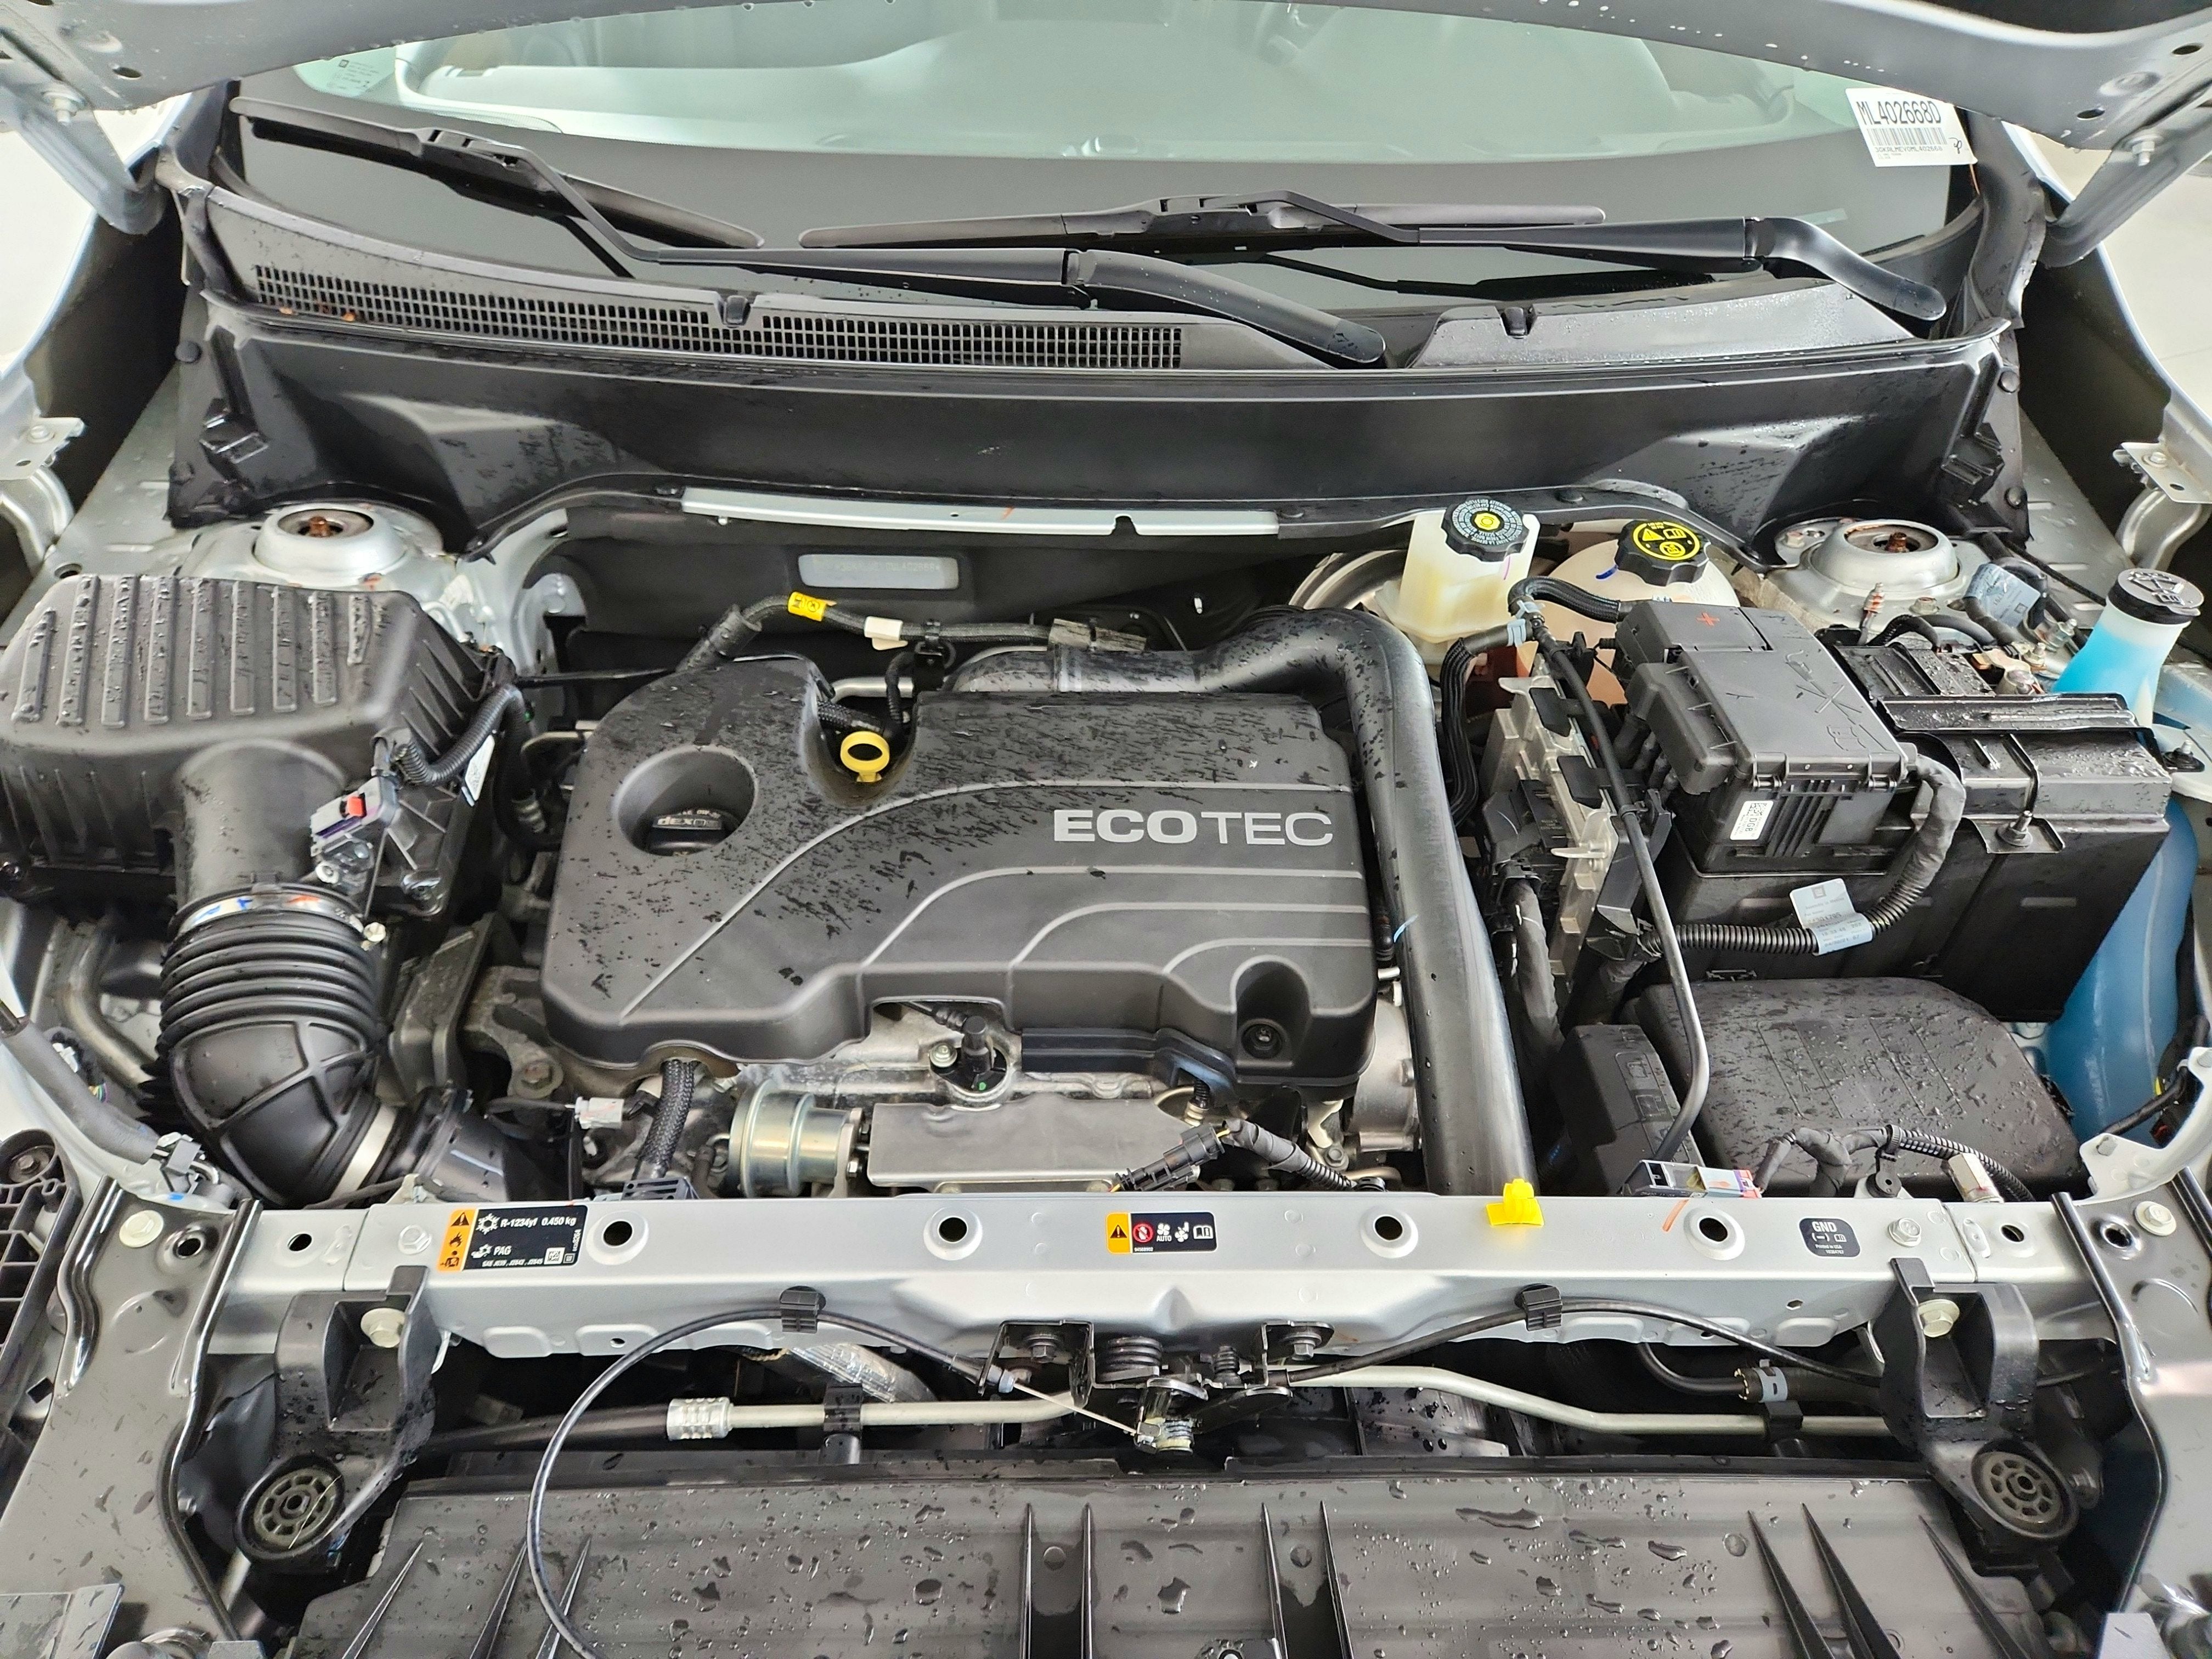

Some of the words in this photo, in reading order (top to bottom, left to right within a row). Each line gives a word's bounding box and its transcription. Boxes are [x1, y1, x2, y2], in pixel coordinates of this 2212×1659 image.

[1856, 100, 1942, 125] ML402668D
[1053, 809, 1334, 846] ECOTEC
[541, 1217, 564, 1226] 0.450
[565, 1216, 577, 1227] kg
[1812, 1221, 1837, 1233] GND
[493, 1245, 512, 1256] PAG
